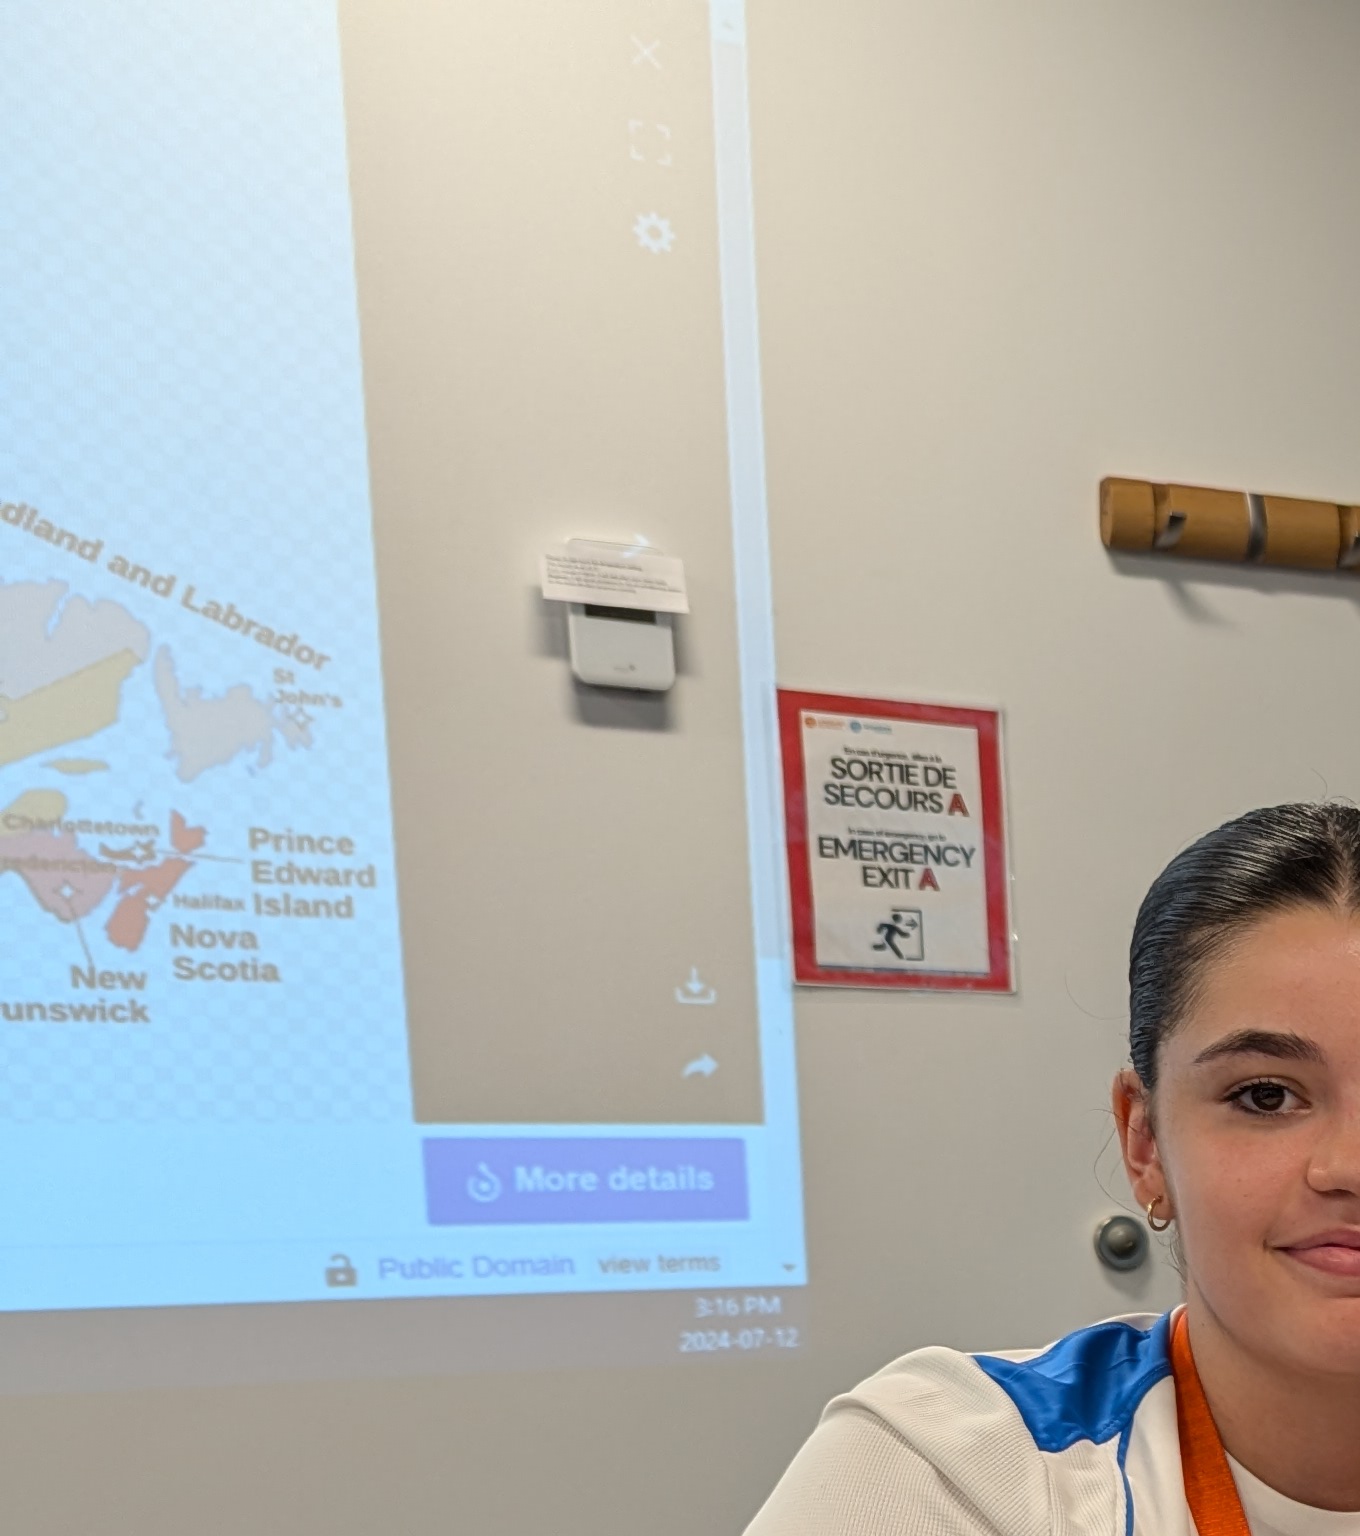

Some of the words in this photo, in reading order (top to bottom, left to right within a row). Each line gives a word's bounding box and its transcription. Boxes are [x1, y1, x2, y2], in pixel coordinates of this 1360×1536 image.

[108, 554, 176, 599] and
[181, 585, 331, 670] Labrador
[831, 756, 920, 787] SORTIE
[924, 765, 957, 789] DE
[824, 783, 944, 815] SECOURS
[948, 793, 970, 818] A
[248, 827, 354, 856] Prince
[818, 834, 976, 869] EMERGENCY
[251, 860, 376, 889] Edward
[862, 865, 916, 891] EXIT
[918, 868, 941, 893] A
[252, 893, 354, 919] Island
[170, 923, 259, 950] Nova
[71, 964, 147, 990] New
[172, 956, 281, 982] Scotia
[515, 1165, 598, 1193] More
[609, 1164, 715, 1193] details
[378, 1257, 464, 1280] Public
[473, 1255, 575, 1279] Domain
[598, 1256, 650, 1275] view
[658, 1254, 721, 1274] terms
[744, 1295, 782, 1315] PM
[679, 1328, 799, 1353] 2024-07-12
